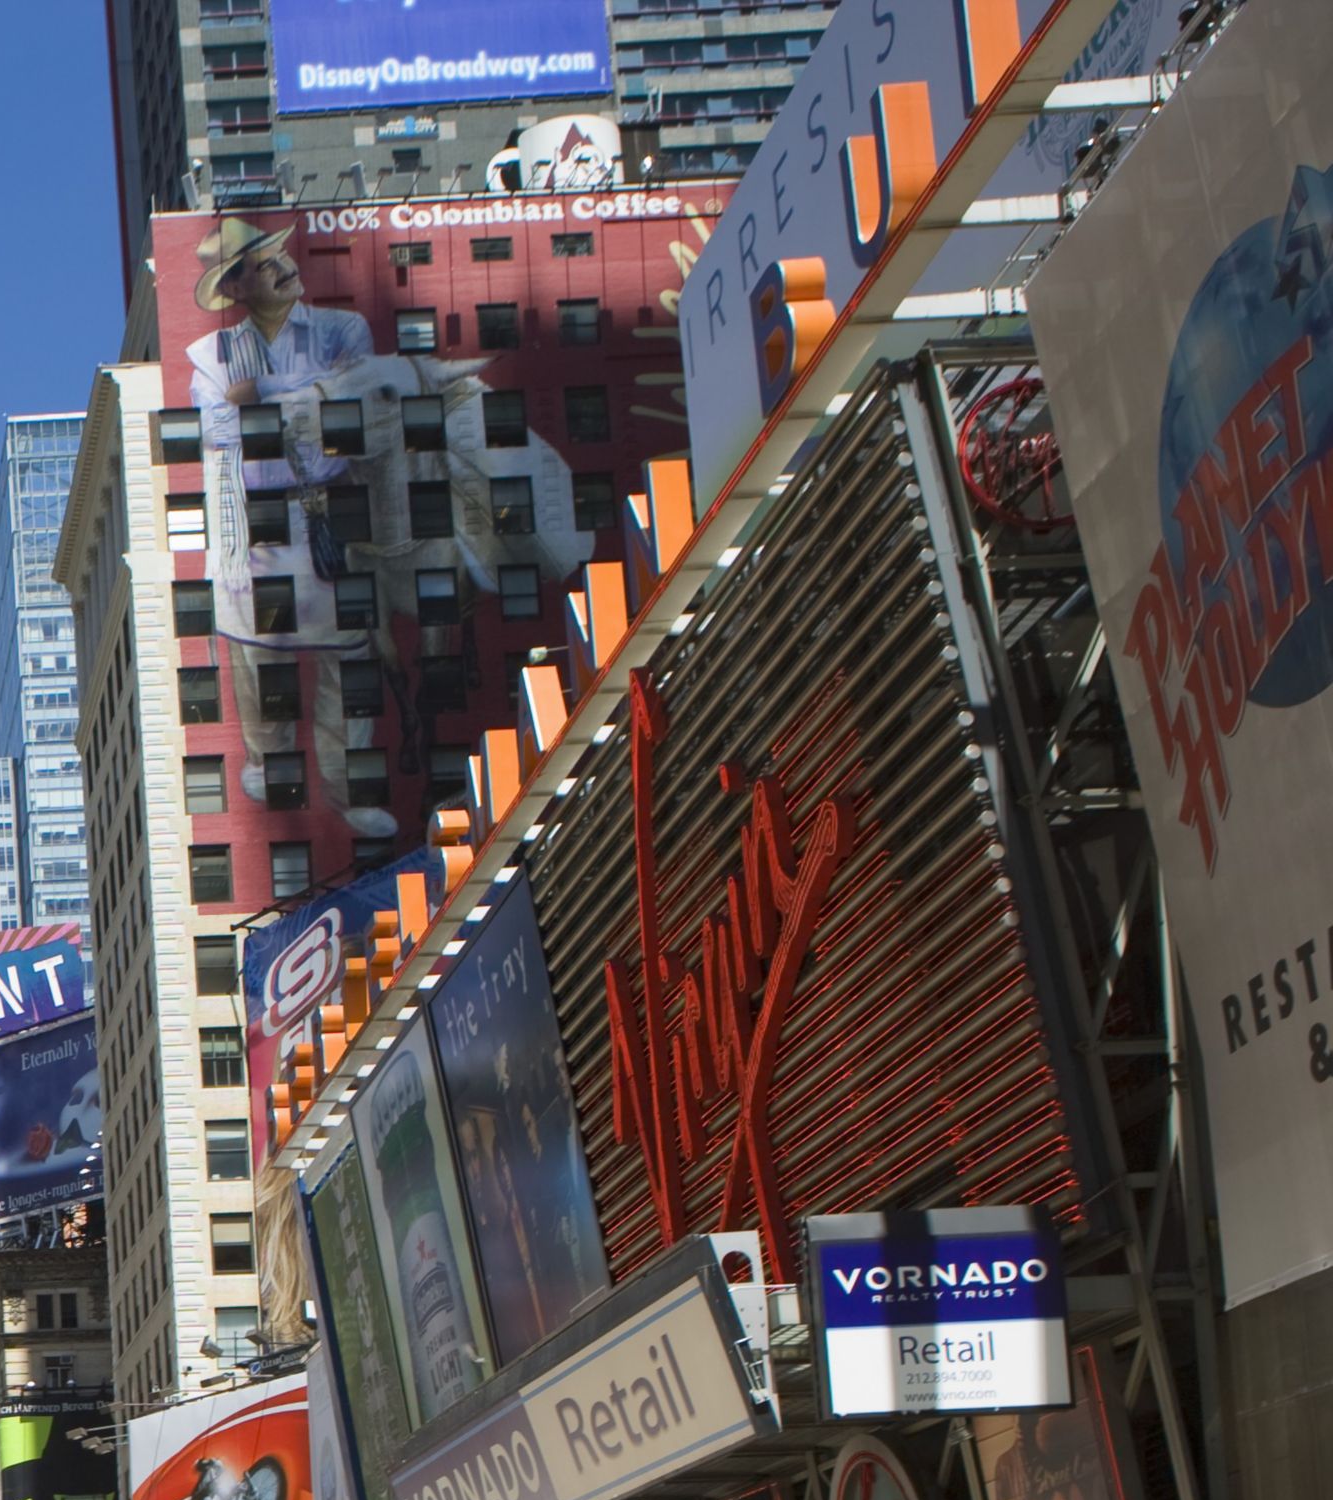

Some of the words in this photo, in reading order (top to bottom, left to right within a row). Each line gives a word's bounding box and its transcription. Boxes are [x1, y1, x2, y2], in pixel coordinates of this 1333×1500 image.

[299, 49, 596, 92] DisneyOnBroadway.com
[306, 205, 381, 233] 100%
[390, 194, 565, 230] Colombian
[571, 193, 682, 222] Coffee
[1124, 333, 1316, 779] PLANET
[444, 998, 480, 1060] the
[478, 936, 530, 1030] fray
[604, 667, 856, 1294] Virgin
[21, 1036, 81, 1072] Eternally
[7, 1178, 95, 1214] longest-running
[833, 1258, 1049, 1294] VORNADO
[871, 1291, 944, 1304] REALTY
[952, 1287, 1018, 1299] TRUST
[898, 1330, 996, 1366] Retail
[429, 1348, 465, 1396] LIGHT
[906, 1369, 993, 1385] 212.894.7000
[14, 1403, 61, 1414] HAPPENED
[62, 1402, 95, 1413] BEFORE
[555, 1333, 696, 1474] Retail
[904, 1388, 998, 1403] www.vno.com
